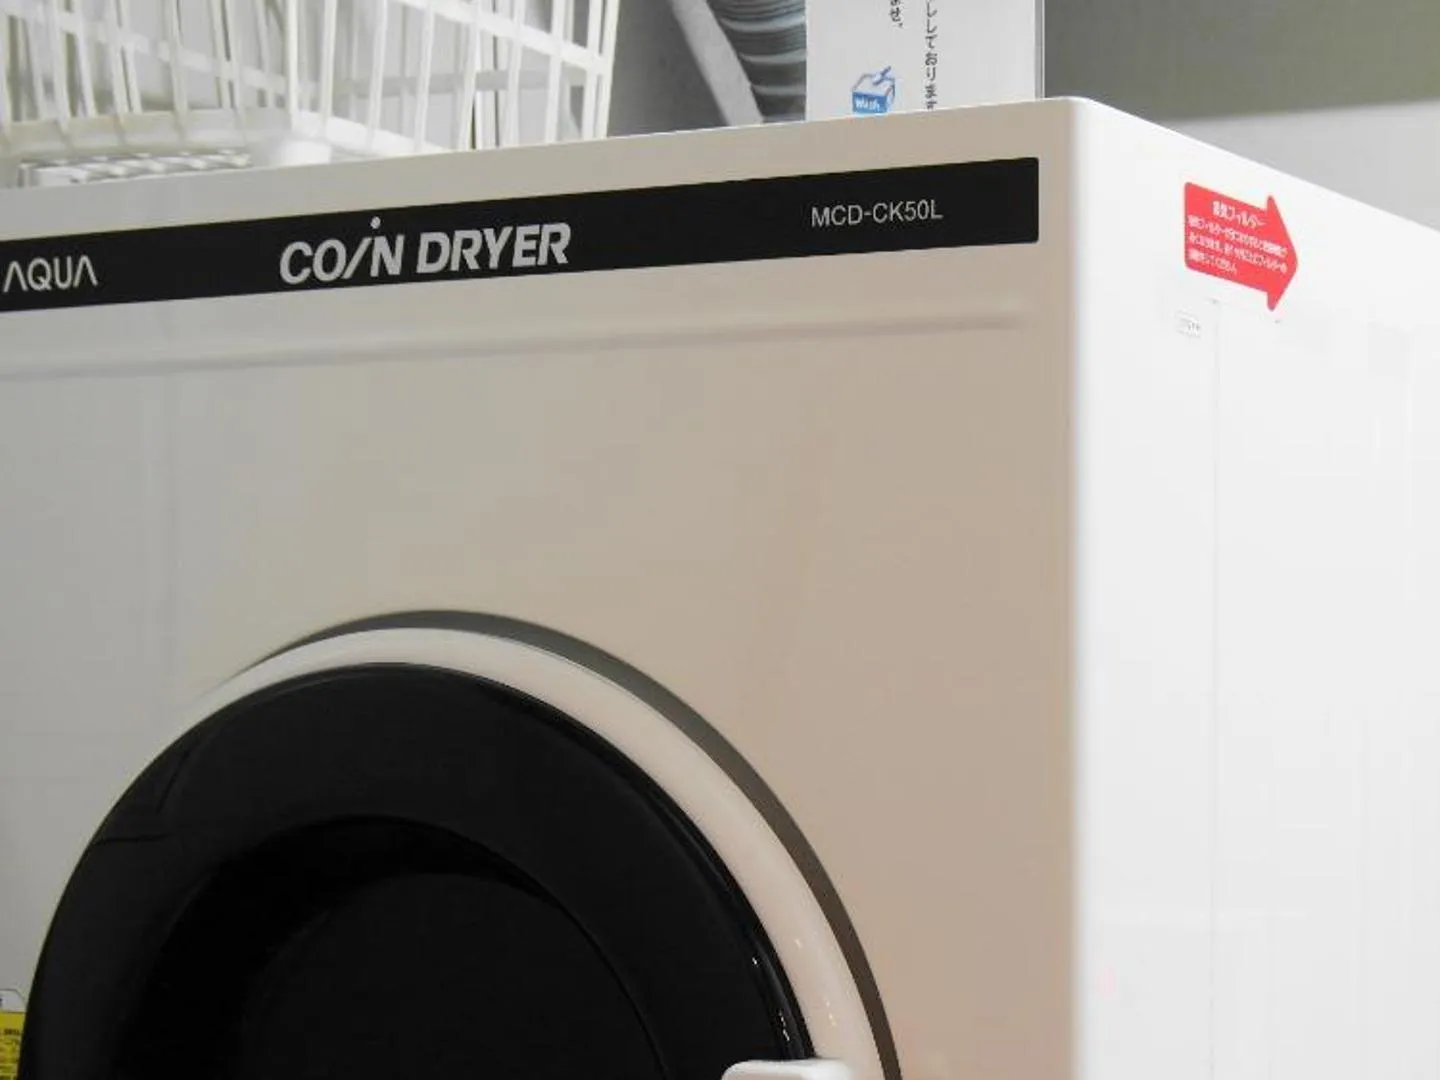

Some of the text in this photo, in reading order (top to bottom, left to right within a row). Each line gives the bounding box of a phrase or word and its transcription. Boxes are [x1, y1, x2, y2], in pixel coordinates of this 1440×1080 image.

[811, 199, 944, 228] MCD-CK50L
[279, 216, 571, 285] COIN DRYER
[3, 255, 98, 292] AQUA
